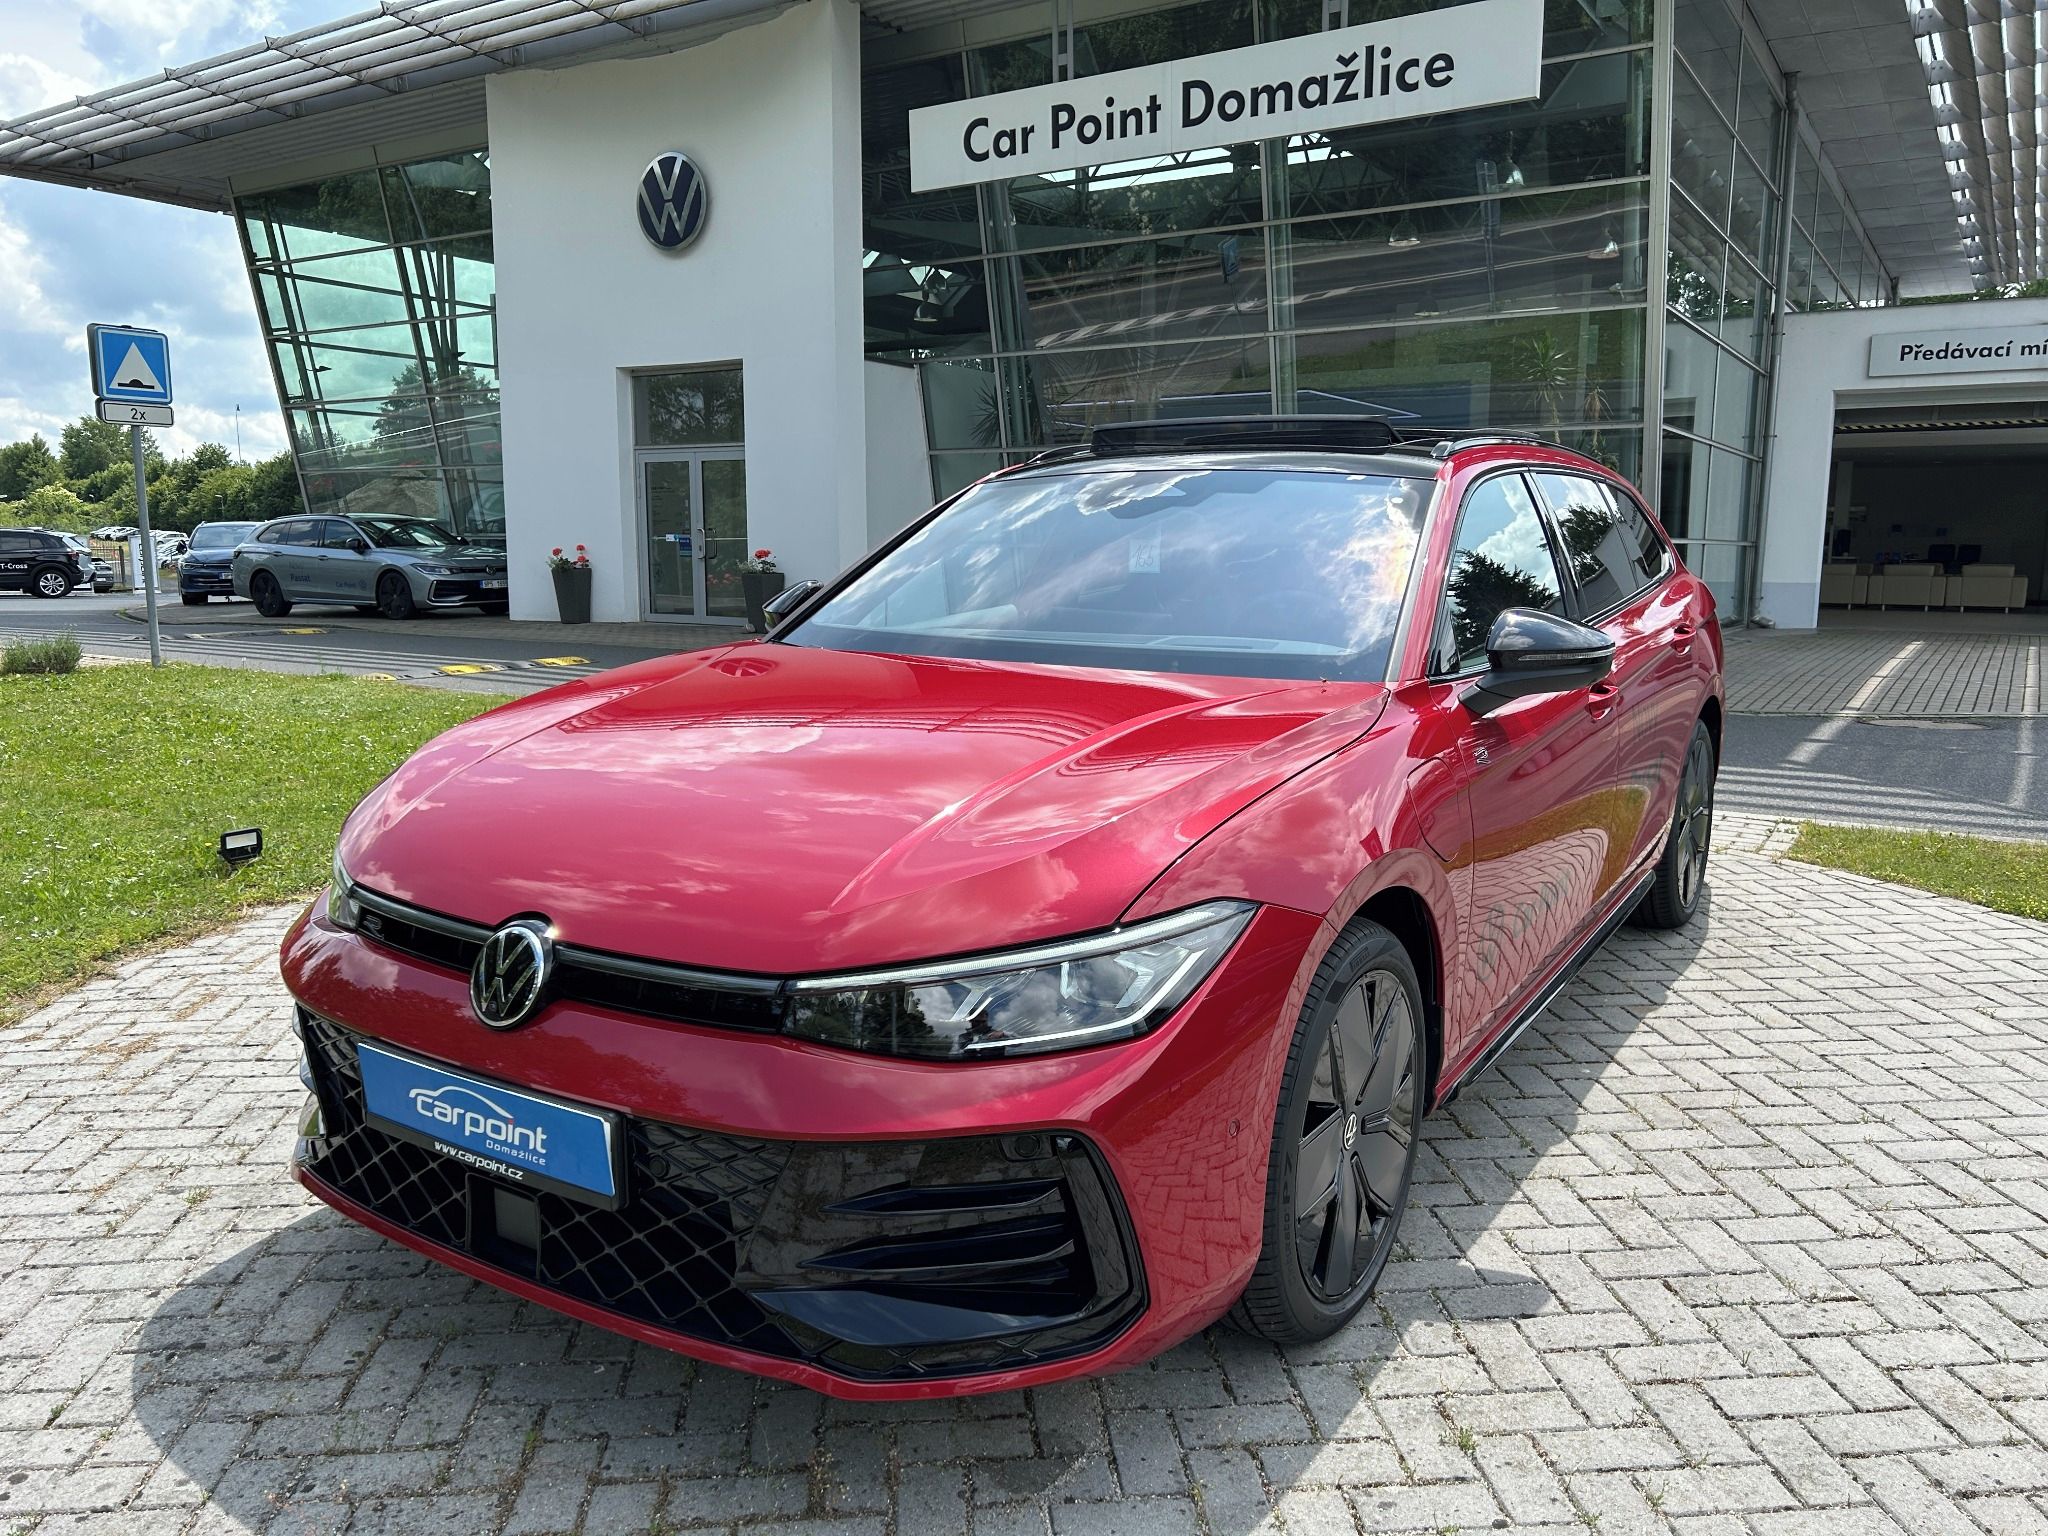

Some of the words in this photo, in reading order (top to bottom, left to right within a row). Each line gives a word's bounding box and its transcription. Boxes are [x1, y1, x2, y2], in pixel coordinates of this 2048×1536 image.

[963, 117, 1035, 162] Car
[1051, 94, 1162, 149] Point
[1181, 44, 1455, 129] Domažlice
[1899, 340, 2014, 361] Předávací
[130, 407, 147, 421] 2x
[0, 562, 28, 570] T-Cross
[416, 1095, 548, 1154] carpoint
[433, 1141, 524, 1180] www.carpoint.cz
[485, 1139, 547, 1166] Domažlice
